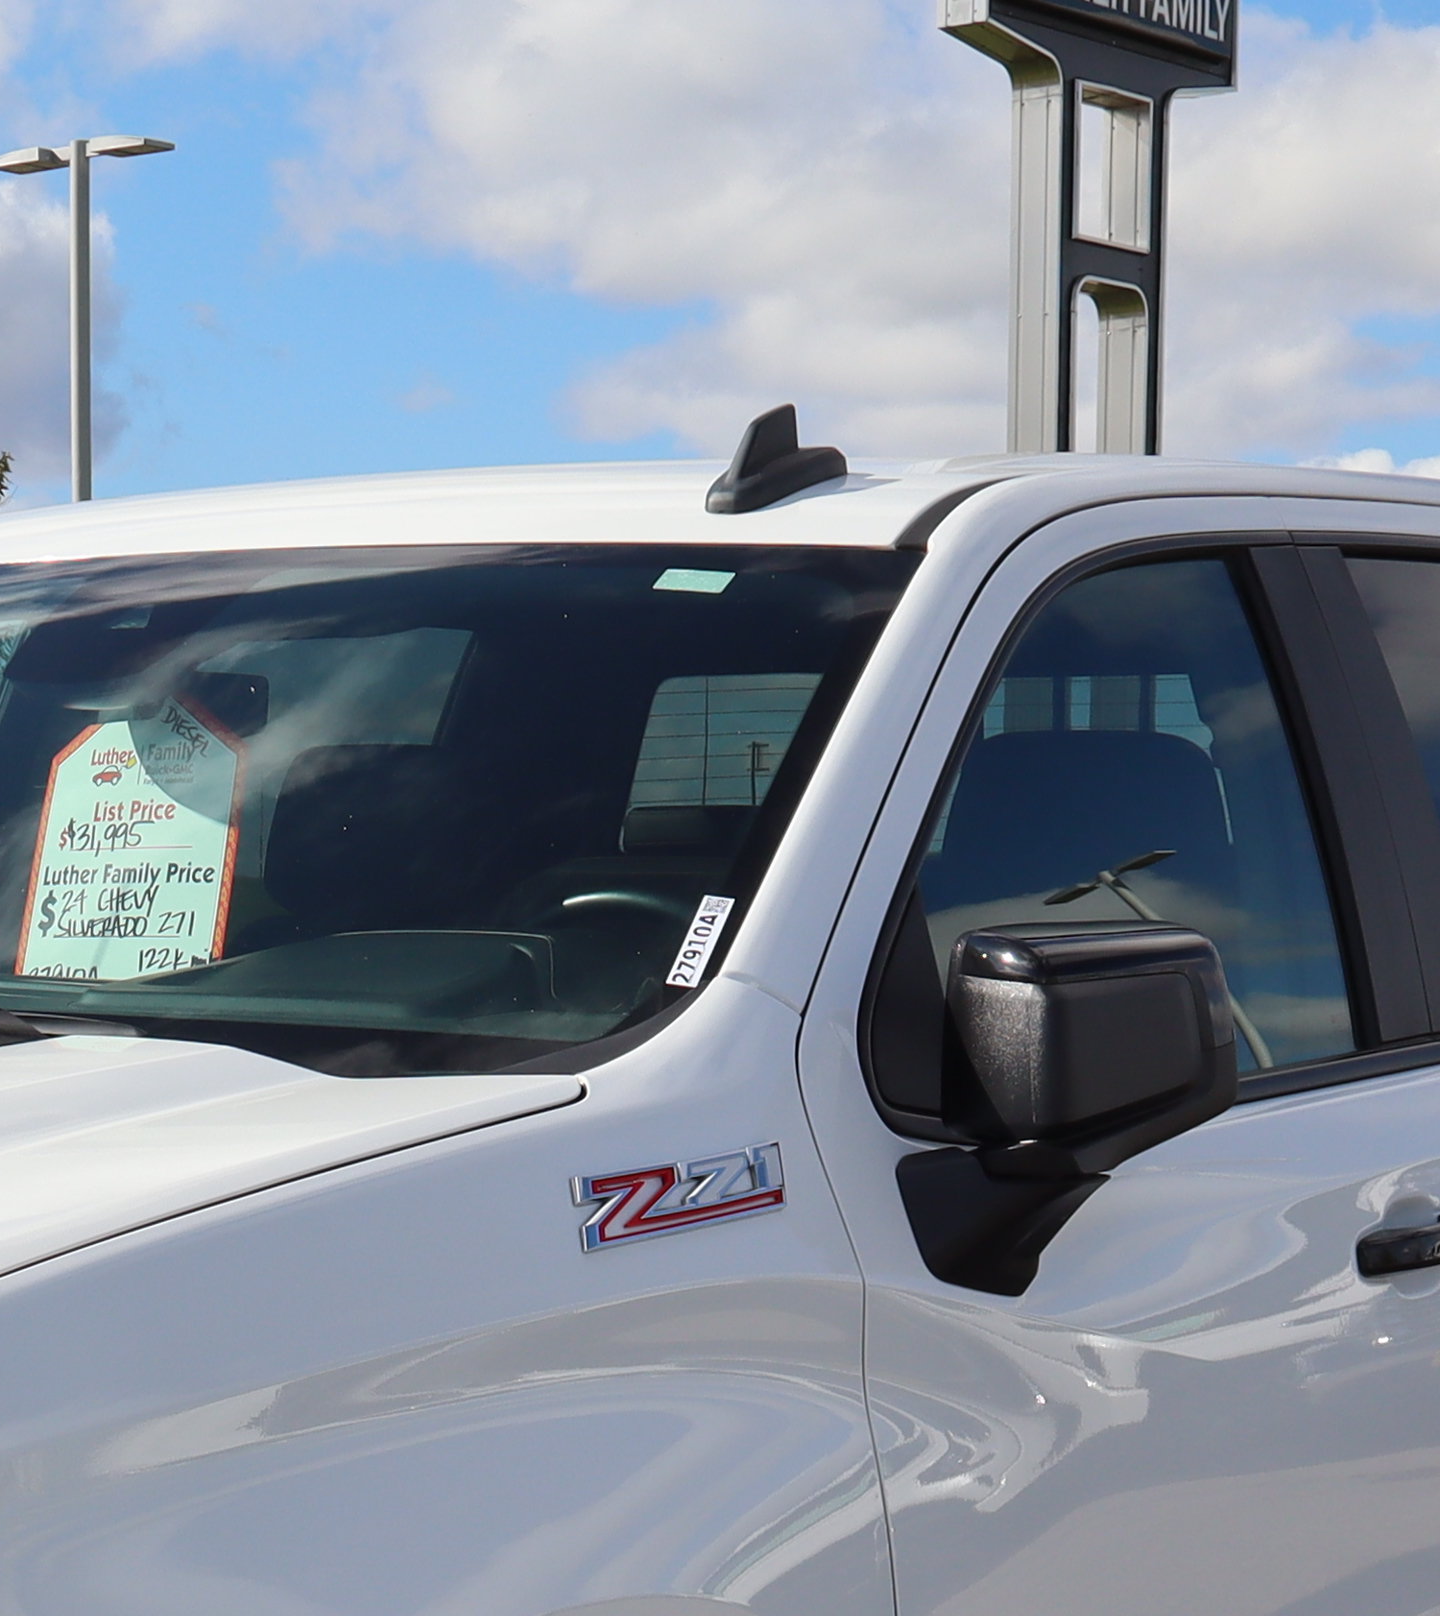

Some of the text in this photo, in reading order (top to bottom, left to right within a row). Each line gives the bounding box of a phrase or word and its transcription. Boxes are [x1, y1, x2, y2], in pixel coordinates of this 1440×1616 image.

[161, 706, 209, 758] DIESEL
[90, 741, 195, 766] Luther Family
[93, 799, 176, 824] List Price
[43, 862, 216, 888] Luther Family Price
[38, 886, 159, 937] $ 24 CHEVY
[54, 911, 147, 937] SILVERADO
[672, 915, 718, 983] 27910A
[570, 1141, 787, 1252] Z71
